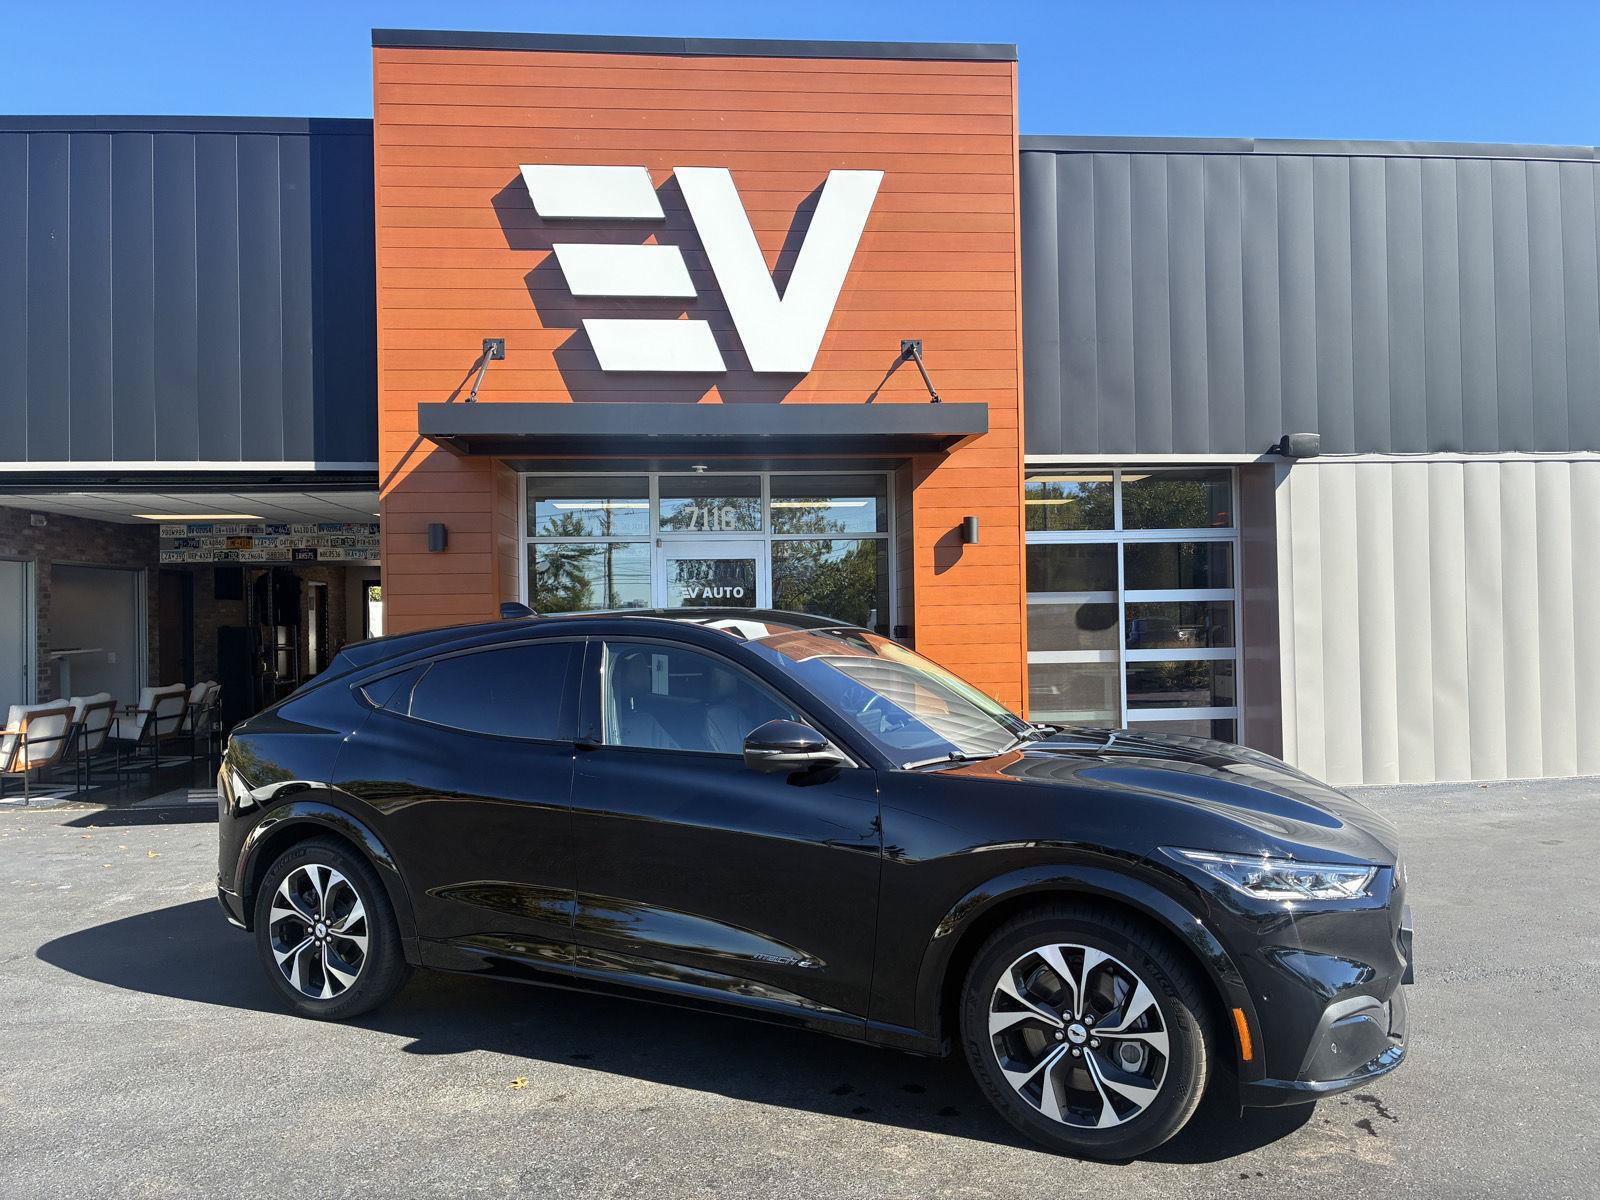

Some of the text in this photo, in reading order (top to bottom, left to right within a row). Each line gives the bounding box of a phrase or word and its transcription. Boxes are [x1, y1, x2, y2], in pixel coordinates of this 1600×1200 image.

[519, 164, 885, 373] EV
[684, 506, 737, 531] 7116
[681, 587, 744, 599] EV AUTO
